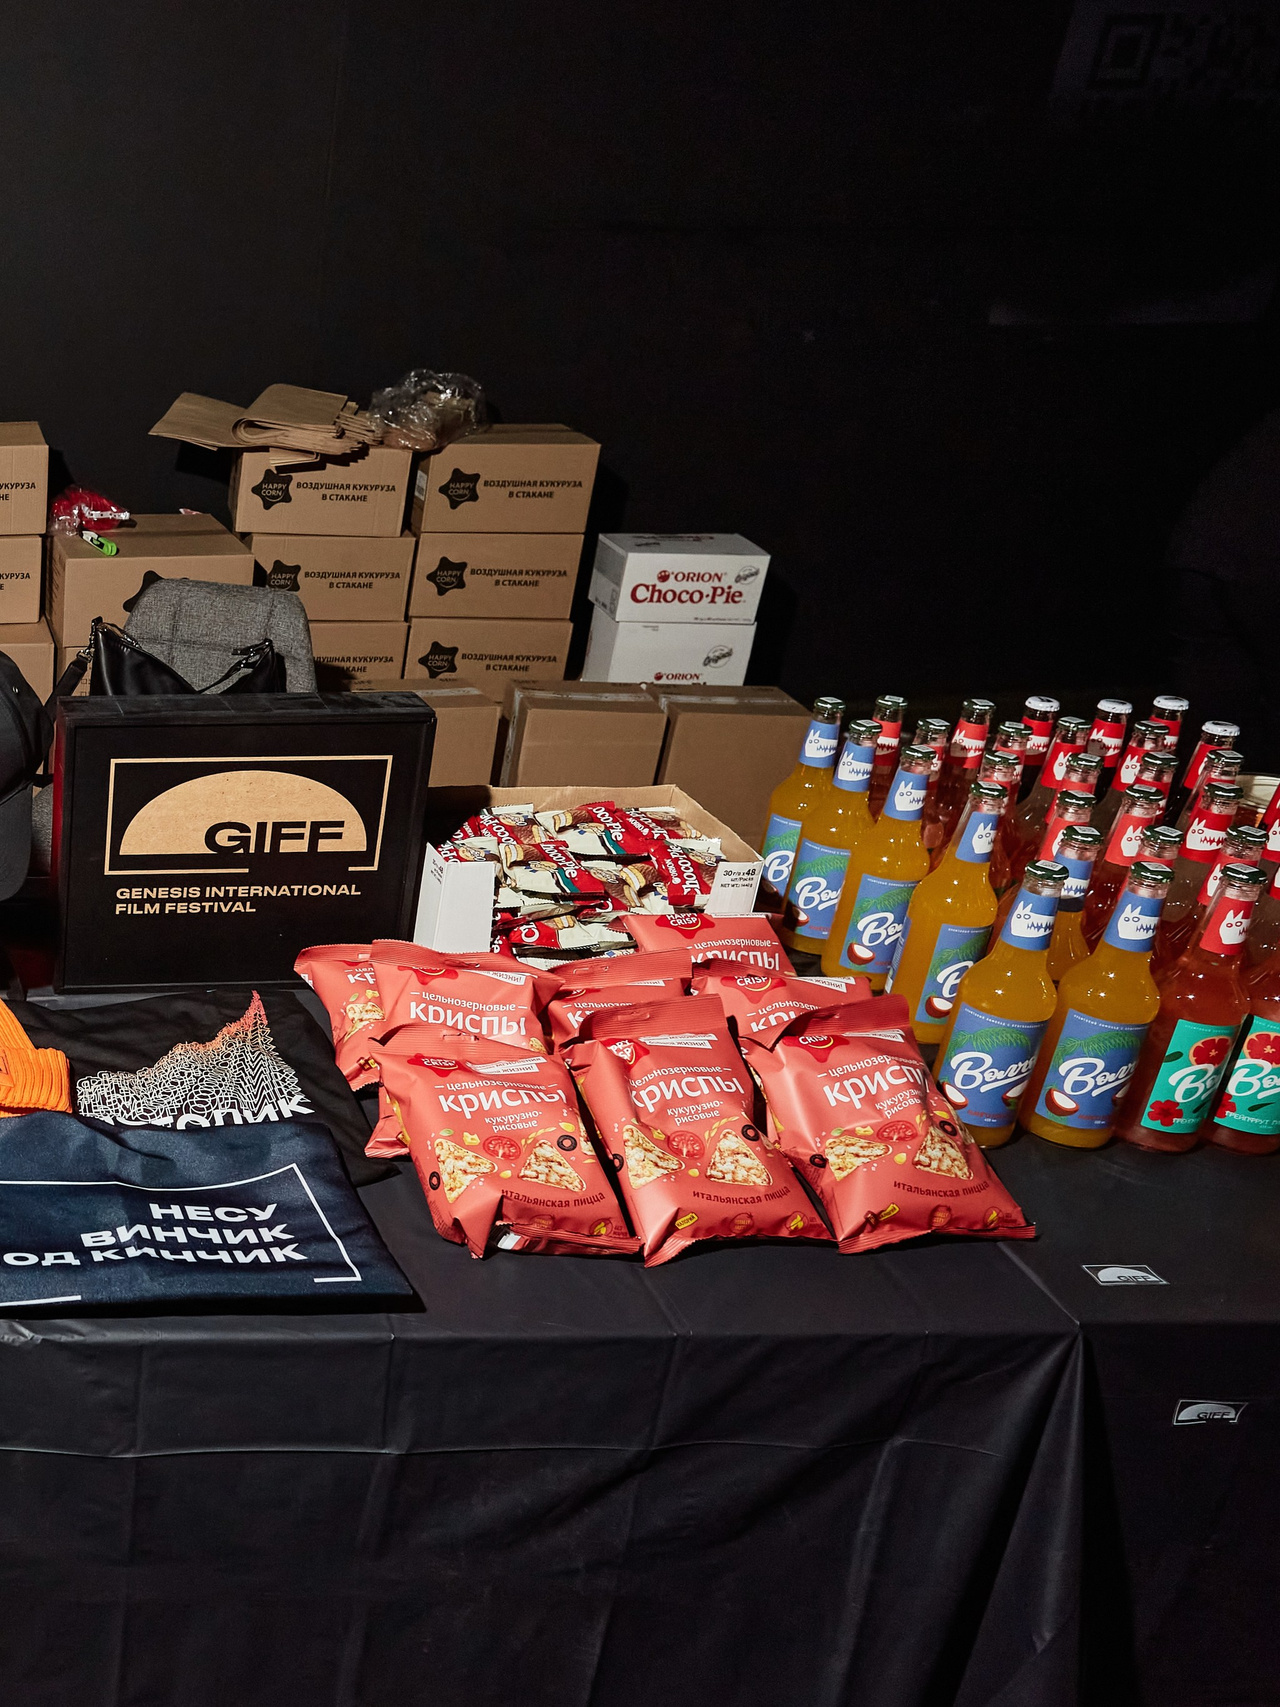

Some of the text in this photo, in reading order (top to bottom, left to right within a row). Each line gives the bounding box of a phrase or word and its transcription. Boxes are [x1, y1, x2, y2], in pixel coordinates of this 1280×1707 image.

[296, 482, 396, 492] ВОЗДУШНАЯ КУКУРУЗА
[484, 480, 582, 488] ВОЗДУШНАЯ КУКУРУЗА
[329, 494, 368, 502] СТАКАНЕ
[304, 572, 356, 580] ВОЗДУШНАЯ
[470, 568, 523, 577] ВОЗДУШНАЯ
[674, 572, 722, 582] ORION
[352, 656, 394, 664] КУКУРУЗА
[429, 654, 453, 662] HAPPY
[462, 654, 558, 662] ВОЗДУШНАЯ КУКУРУЗА
[493, 664, 530, 672] СТАКАНЕ
[666, 672, 701, 680] ORION
[204, 820, 346, 854] GIFF
[116, 884, 362, 900] GENESIS INTERNATIONAL
[116, 902, 256, 915] FILM FESTIVAL
[670, 916, 698, 926] CRISP
[694, 939, 771, 950] цельнозерновые
[736, 976, 768, 986] CRISP
[422, 990, 516, 1012] цельнозерновые
[410, 1002, 526, 1036] криспы
[798, 1036, 829, 1046] CRISP
[447, 1079, 546, 1092] цельнозерновые
[438, 1090, 566, 1119] криспы
[667, 1100, 724, 1116] кукурузно-
[484, 1110, 542, 1126] кукурузно-
[675, 1110, 720, 1126] рисовые
[492, 1120, 538, 1134] рисовые
[692, 1186, 791, 1205] итальянская пицца
[894, 1180, 990, 1198] итальянская пицца
[502, 1189, 606, 1208] итальянская пицца
[149, 1203, 278, 1222] НЕСУ
[80, 1223, 295, 1247] ВИНЧИК
[91, 1243, 308, 1264] КИНЧИК
[1196, 1411, 1230, 1420] GIFF
